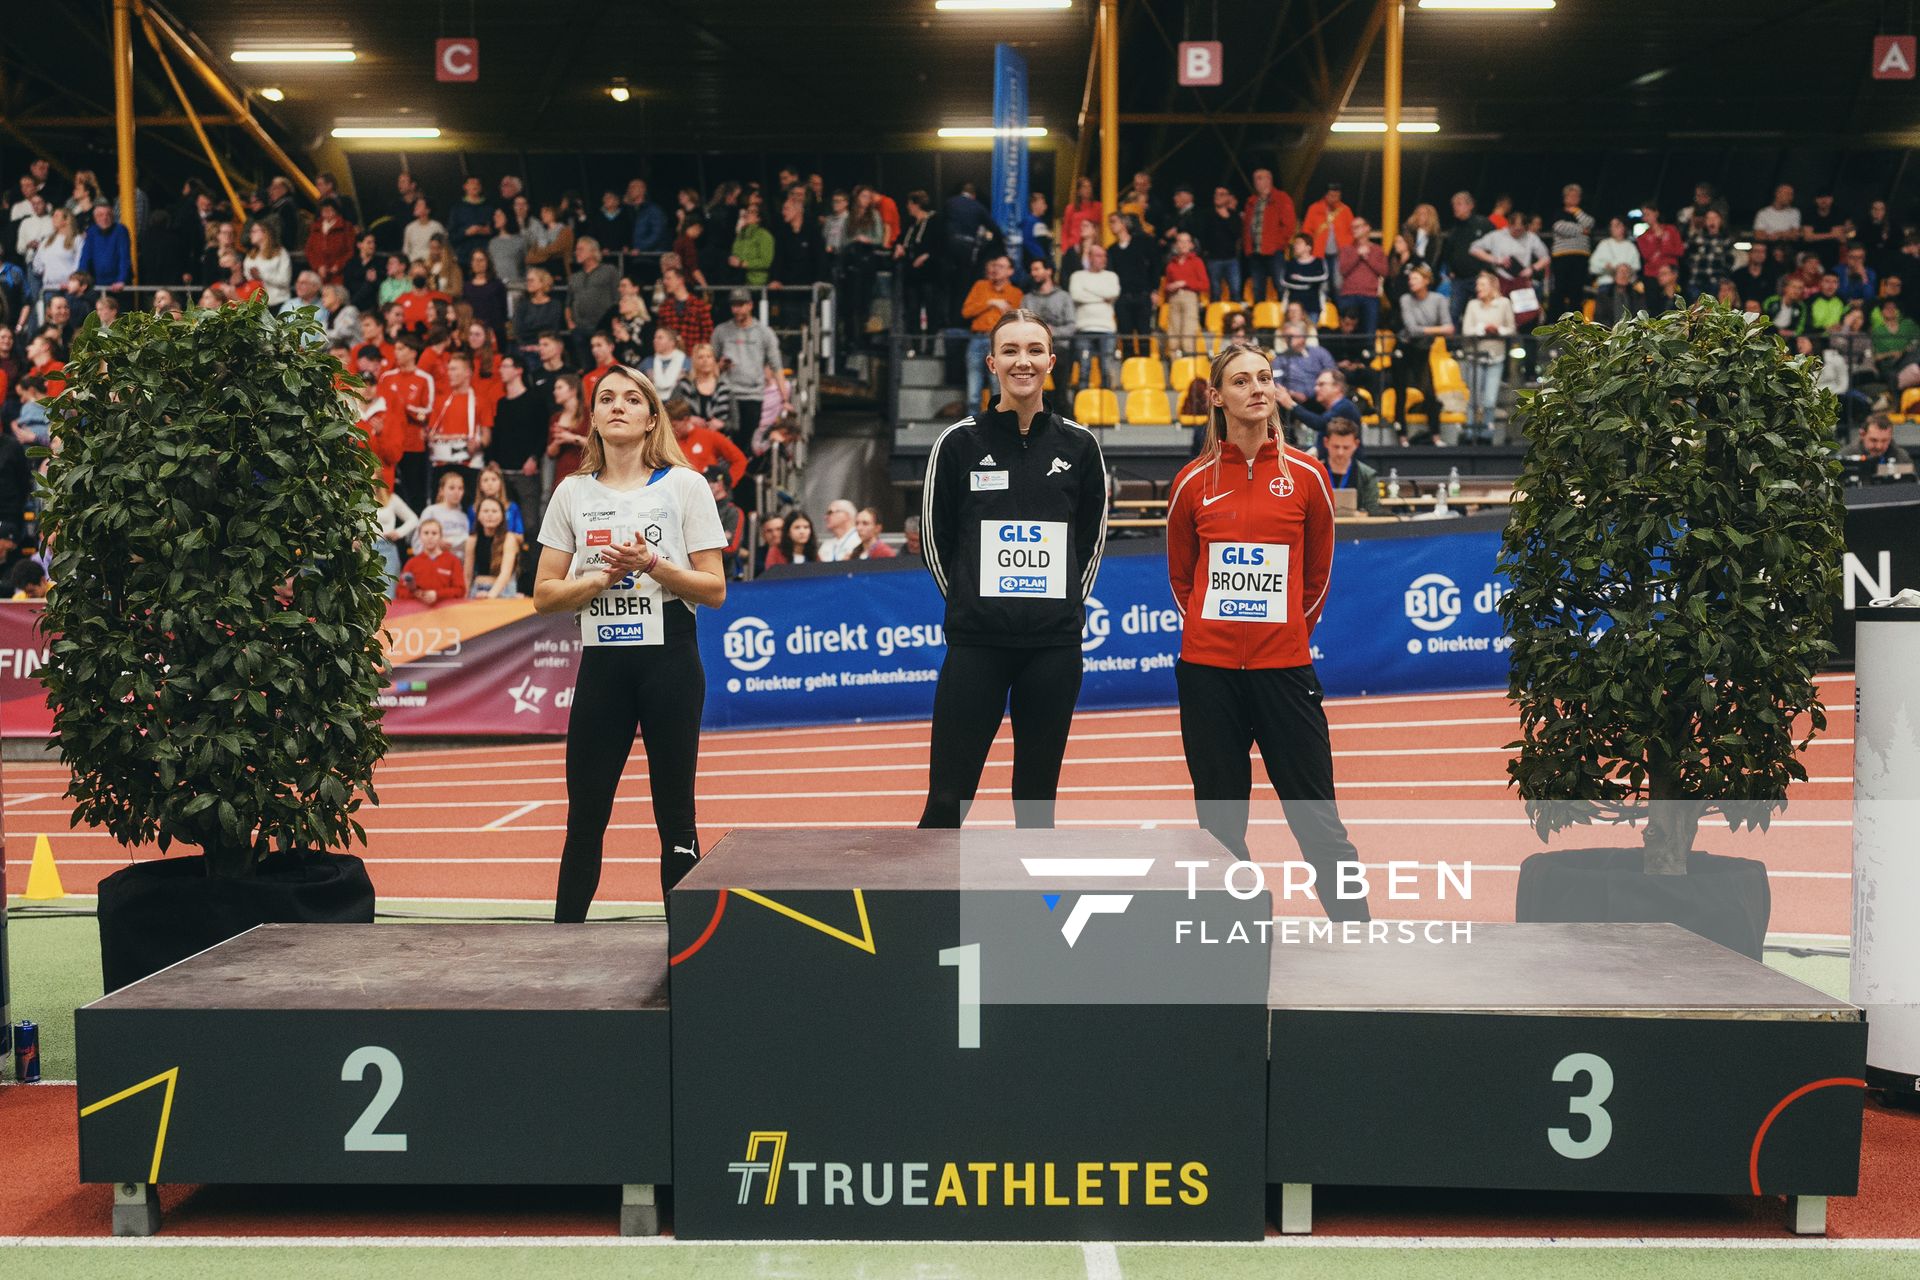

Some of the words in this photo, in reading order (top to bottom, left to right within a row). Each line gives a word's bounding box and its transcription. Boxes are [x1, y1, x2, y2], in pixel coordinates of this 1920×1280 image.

[443, 44, 472, 75] C
[1187, 47, 1211, 79] B
[1879, 42, 1910, 72] A
[998, 549, 1050, 568] GOLD
[1019, 579, 1045, 587] PLAN
[1212, 572, 1283, 592] BRONZE
[590, 597, 652, 616] SILBER
[1238, 603, 1265, 611] PLAN
[1405, 587, 1461, 618] BIG
[388, 627, 462, 657] 2023
[615, 627, 641, 635] PLAN
[723, 629, 775, 659] BIG
[786, 622, 869, 654] direkt
[534, 640, 558, 652] Info
[1427, 635, 1490, 653] Direkter
[533, 656, 569, 668] unter:
[1140, 652, 1174, 673] geht
[745, 674, 802, 692] Direkter
[804, 672, 837, 692] geht
[840, 668, 938, 687] Krankenkasse
[939, 942, 981, 1049] 1
[341, 1045, 408, 1152] 2
[1547, 1052, 1614, 1160] 3
[788, 1161, 1209, 1206] TRUEATHLETES
